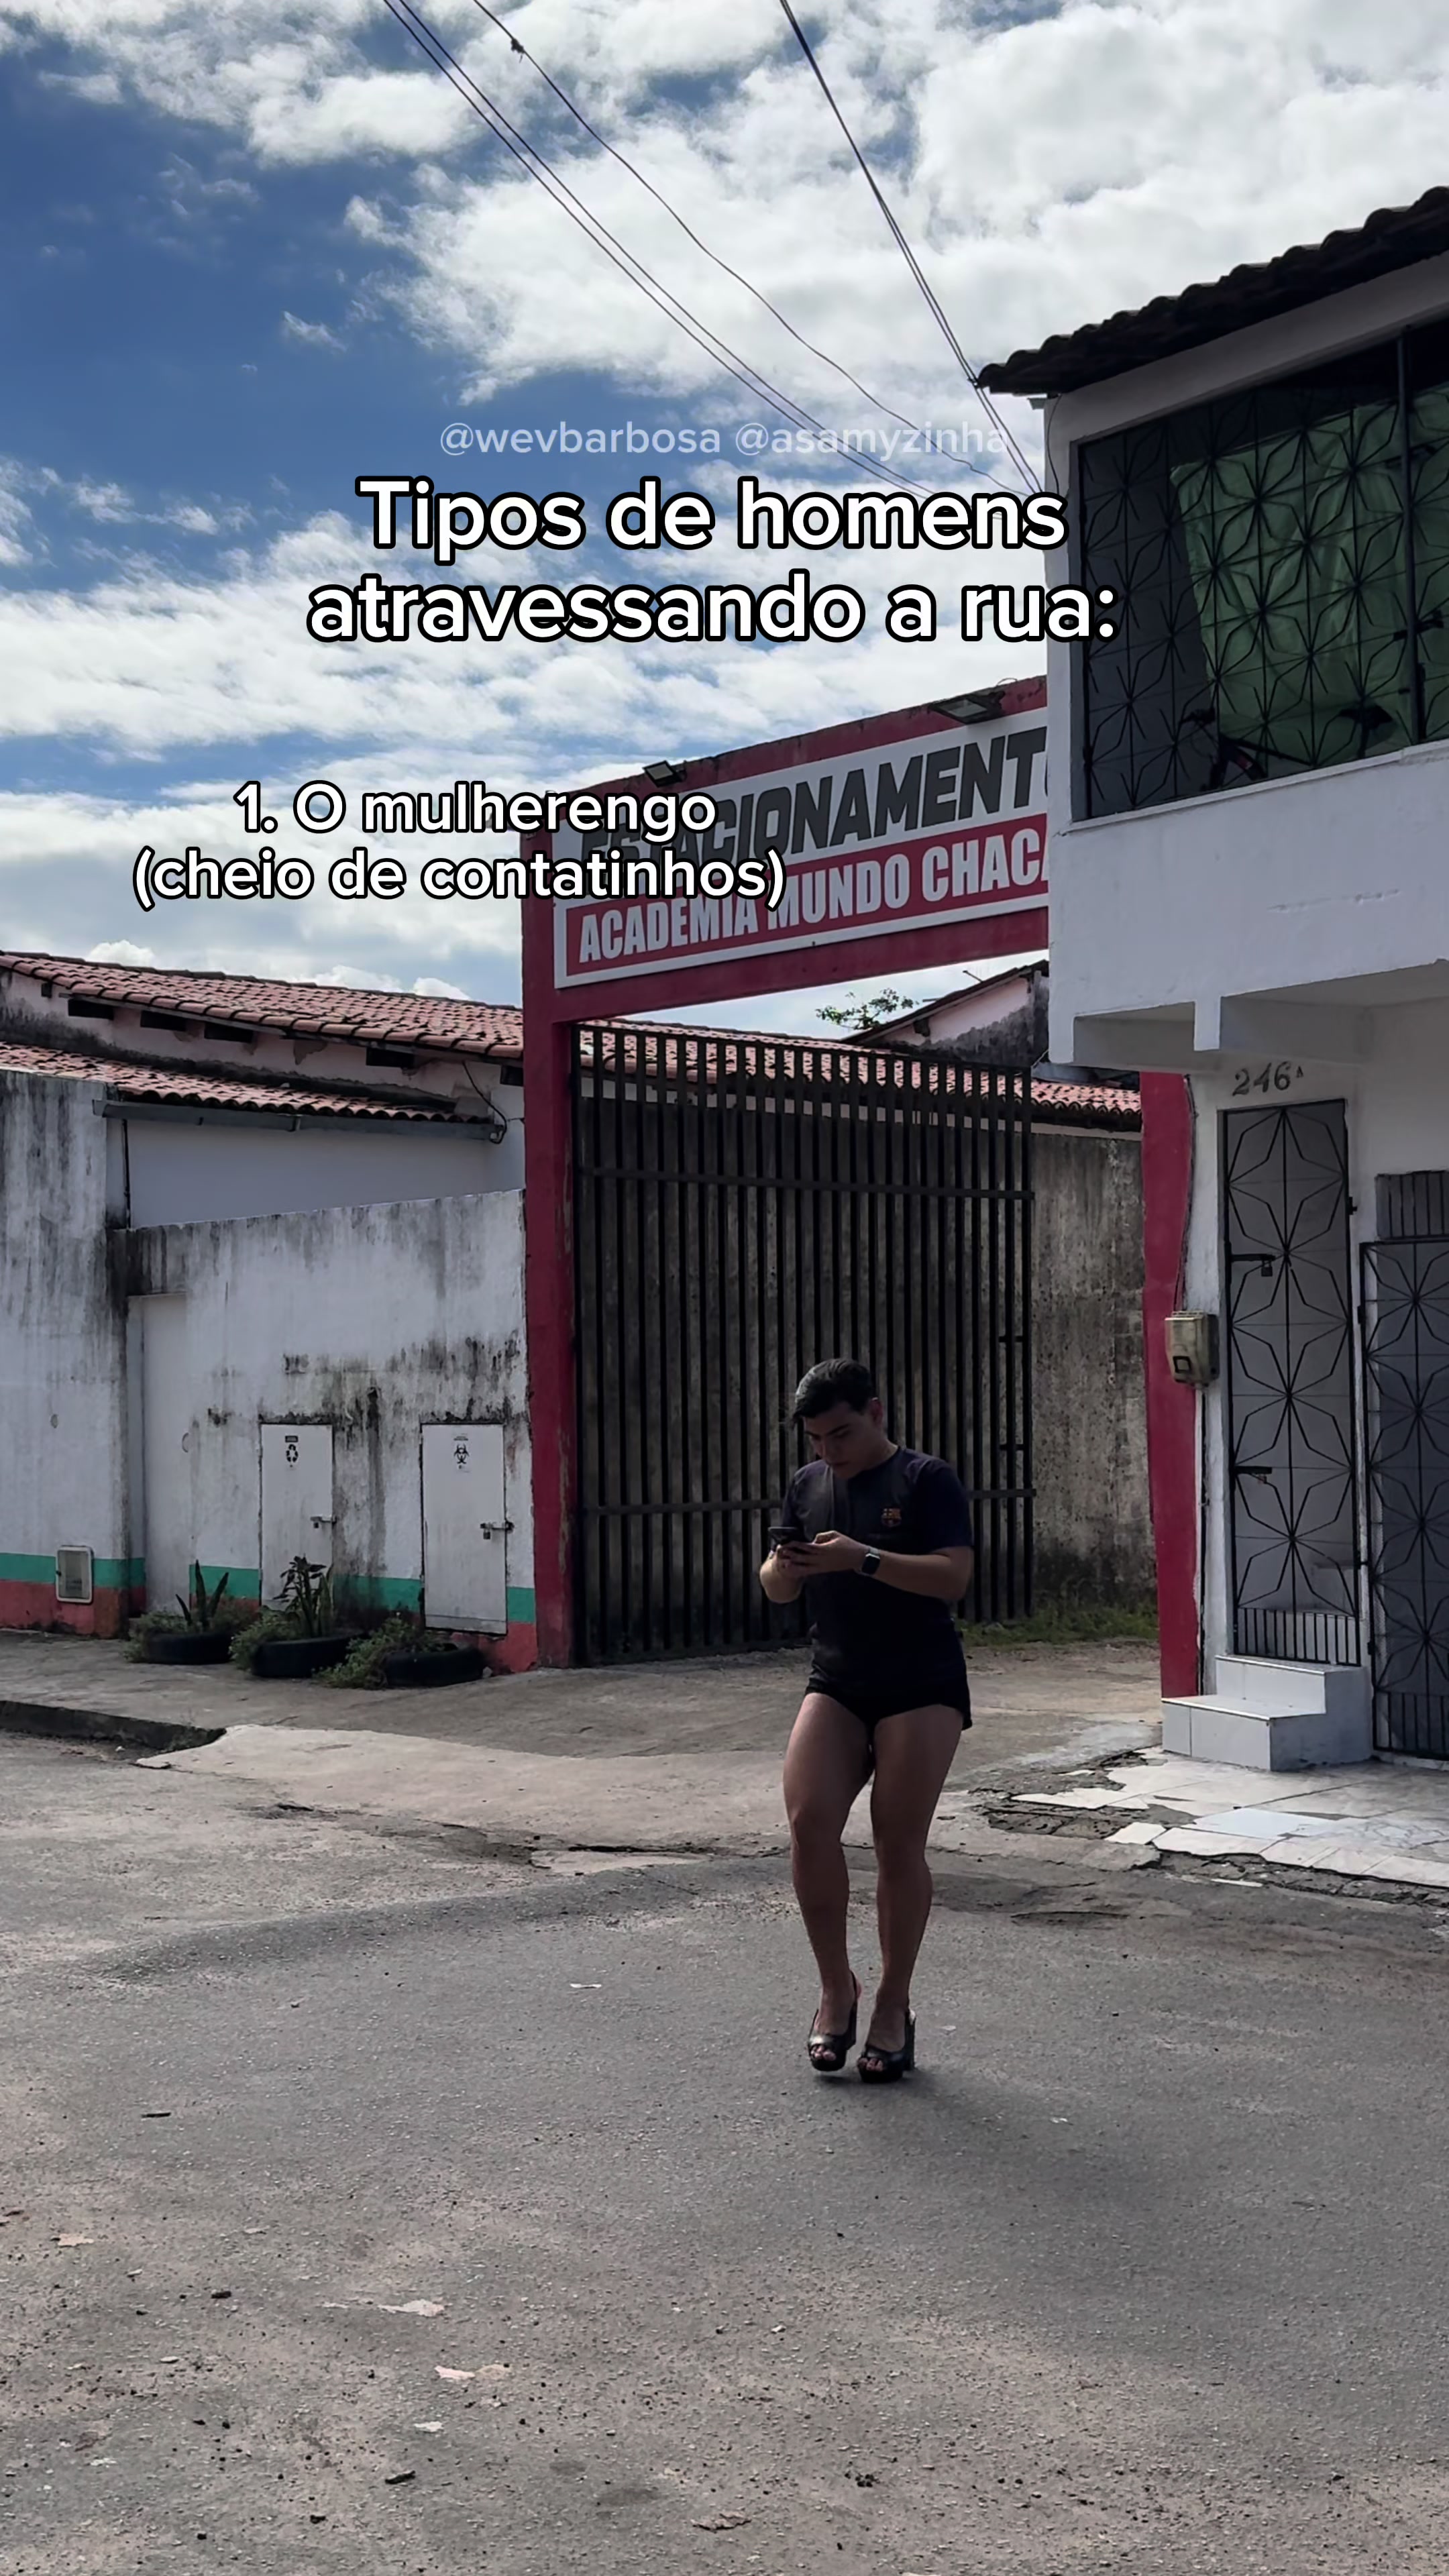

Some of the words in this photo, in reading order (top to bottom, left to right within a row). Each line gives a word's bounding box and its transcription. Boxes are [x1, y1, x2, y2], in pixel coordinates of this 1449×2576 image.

[580, 726, 1048, 896] ESACIONAMENT
[578, 896, 759, 963] ACADEMIA
[767, 853, 910, 930] MUNDO
[921, 828, 1049, 902] CHAC
